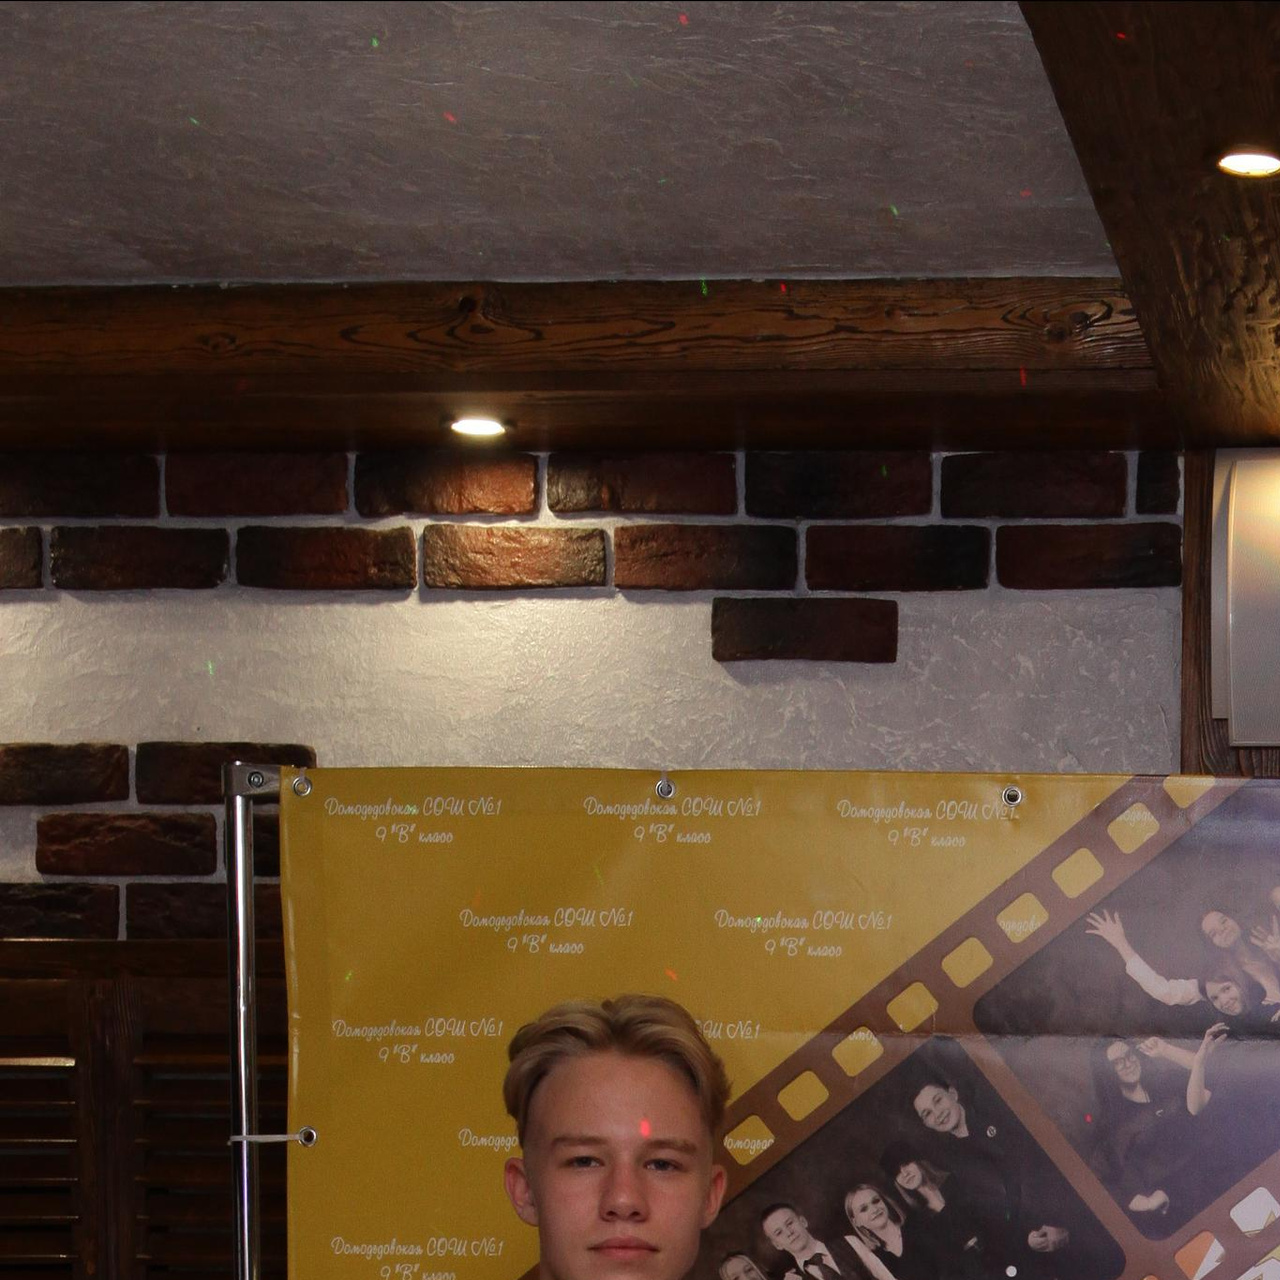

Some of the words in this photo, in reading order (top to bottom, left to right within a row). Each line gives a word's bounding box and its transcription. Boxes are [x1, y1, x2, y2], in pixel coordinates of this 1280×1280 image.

[423, 797, 465, 816] СОШ
[468, 799, 501, 816] №1
[682, 797, 723, 816] СОШ
[727, 799, 761, 816] №1
[935, 801, 979, 820] СОШ
[982, 803, 1014, 820] №1
[376, 826, 387, 842] 9
[634, 826, 645, 842] 9
[888, 829, 899, 846] 9
[554, 909, 596, 928] СОШ
[600, 910, 634, 928] №1
[812, 911, 854, 930] СОШ
[857, 912, 893, 930] №1
[507, 937, 518, 954] 9
[765, 939, 776, 956] 9
[424, 1018, 466, 1037] СОШ
[470, 1018, 503, 1037] №1
[379, 1047, 388, 1062] 9
[459, 1128, 518, 1152] Домодедо
[427, 1237, 467, 1256] СОШ
[471, 1238, 504, 1256] №1
[380, 1266, 391, 1280] 9
